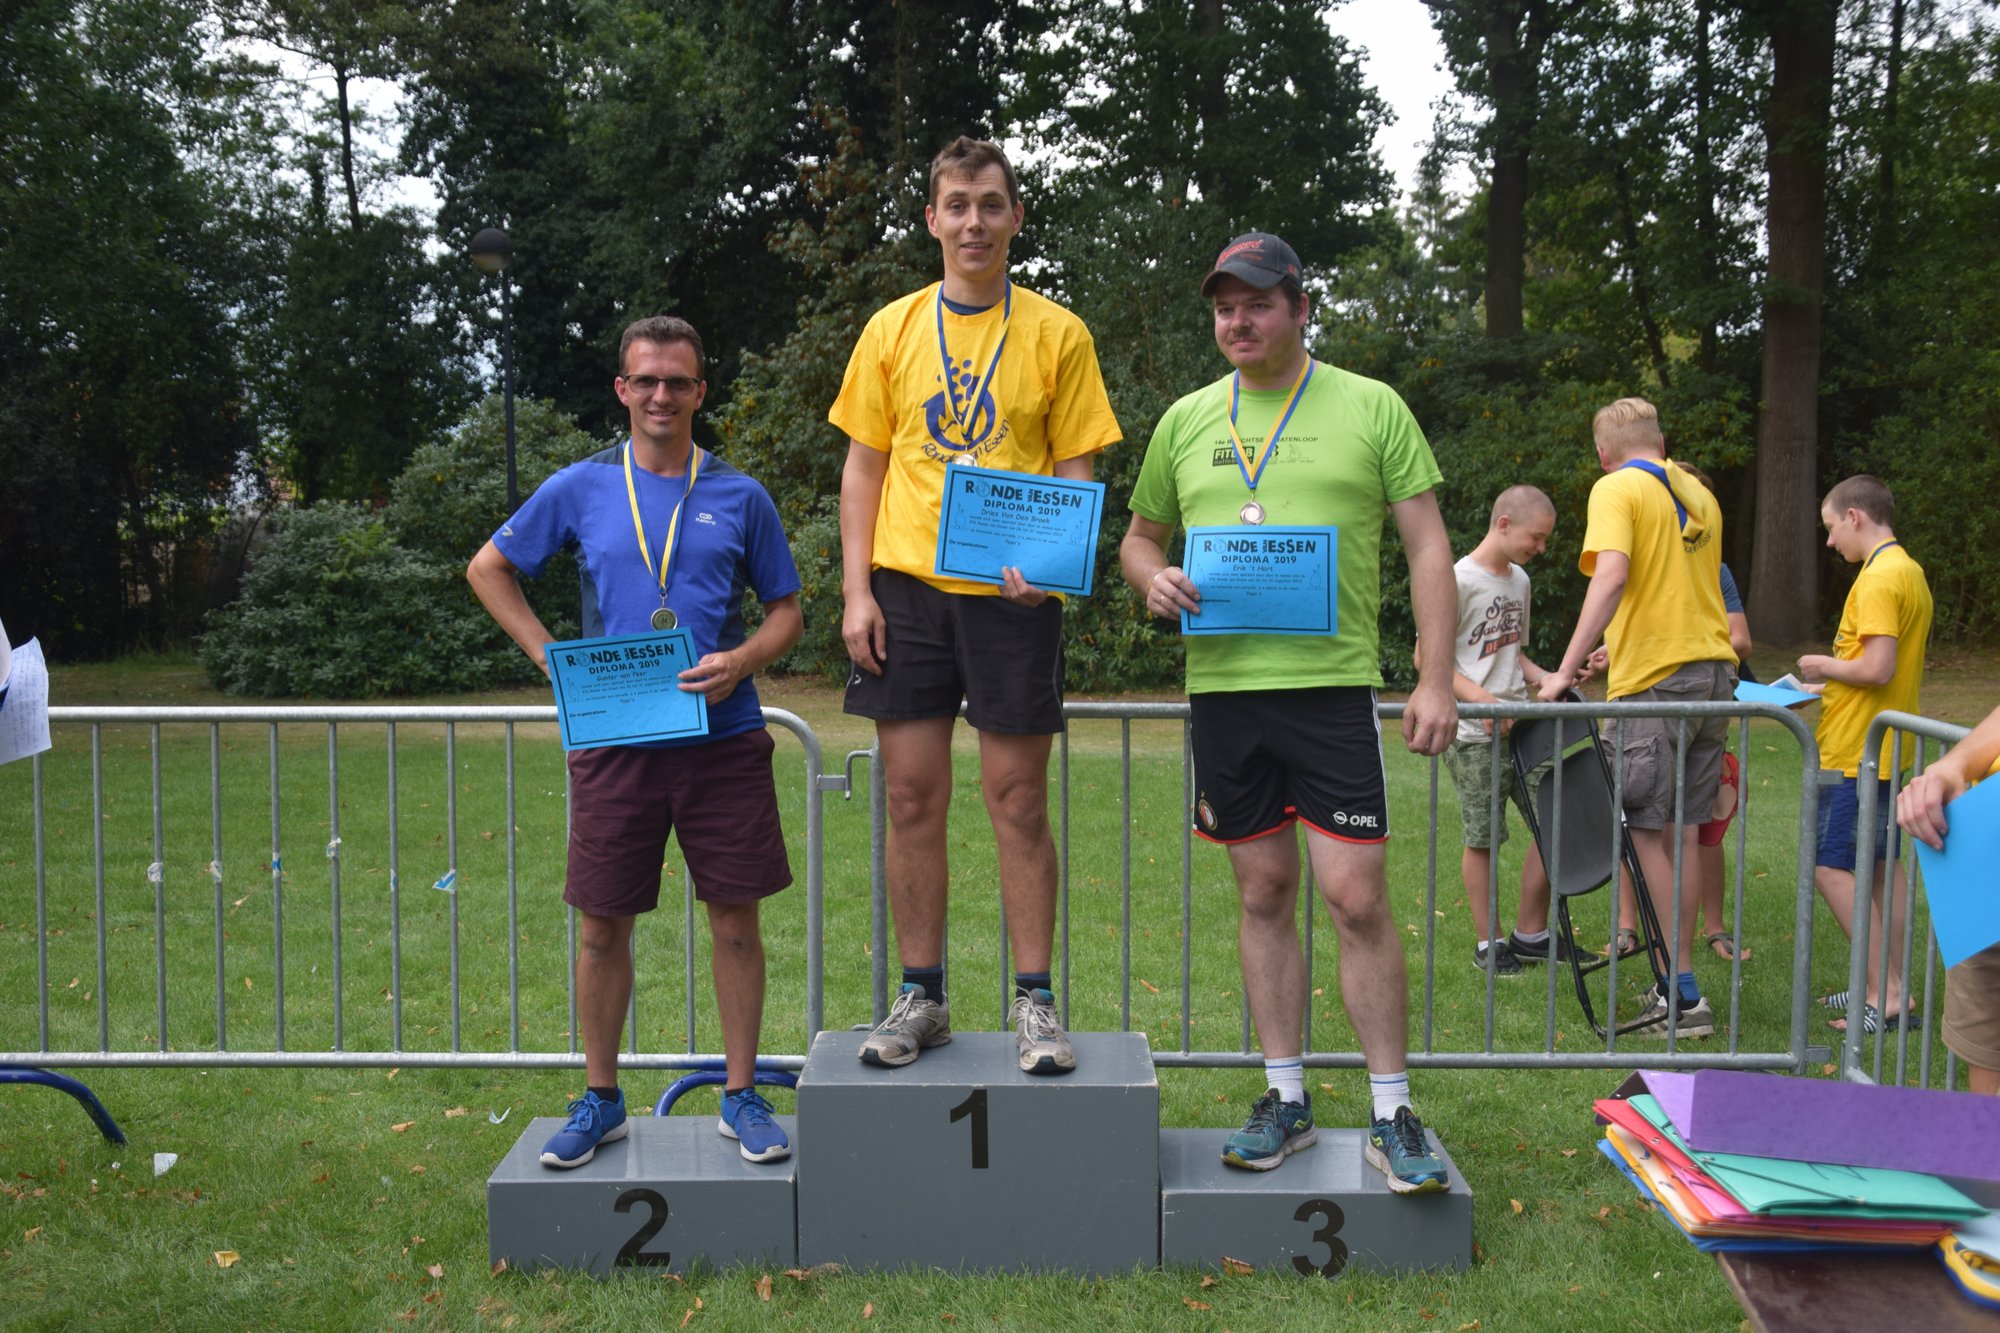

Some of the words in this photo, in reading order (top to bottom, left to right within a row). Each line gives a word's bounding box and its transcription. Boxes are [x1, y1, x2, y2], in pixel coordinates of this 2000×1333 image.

[984, 498, 1033, 514] DIPLOMA
[1038, 506, 1061, 517] 2019
[1033, 489, 1083, 509] ESSEN
[981, 508, 999, 518] Dries
[1016, 513, 1029, 521] Den
[1267, 538, 1316, 554] ESSEN
[1221, 555, 1269, 564] DIPLOMA
[1273, 555, 1297, 564] 2019
[629, 643, 675, 660] ESSEN
[588, 661, 635, 675] DIPLOMA
[638, 659, 660, 669] 2019
[1350, 815, 1378, 827] OPEL
[950, 1089, 989, 1169] 1
[614, 1188, 670, 1267] 2
[1292, 1199, 1348, 1279] 3
